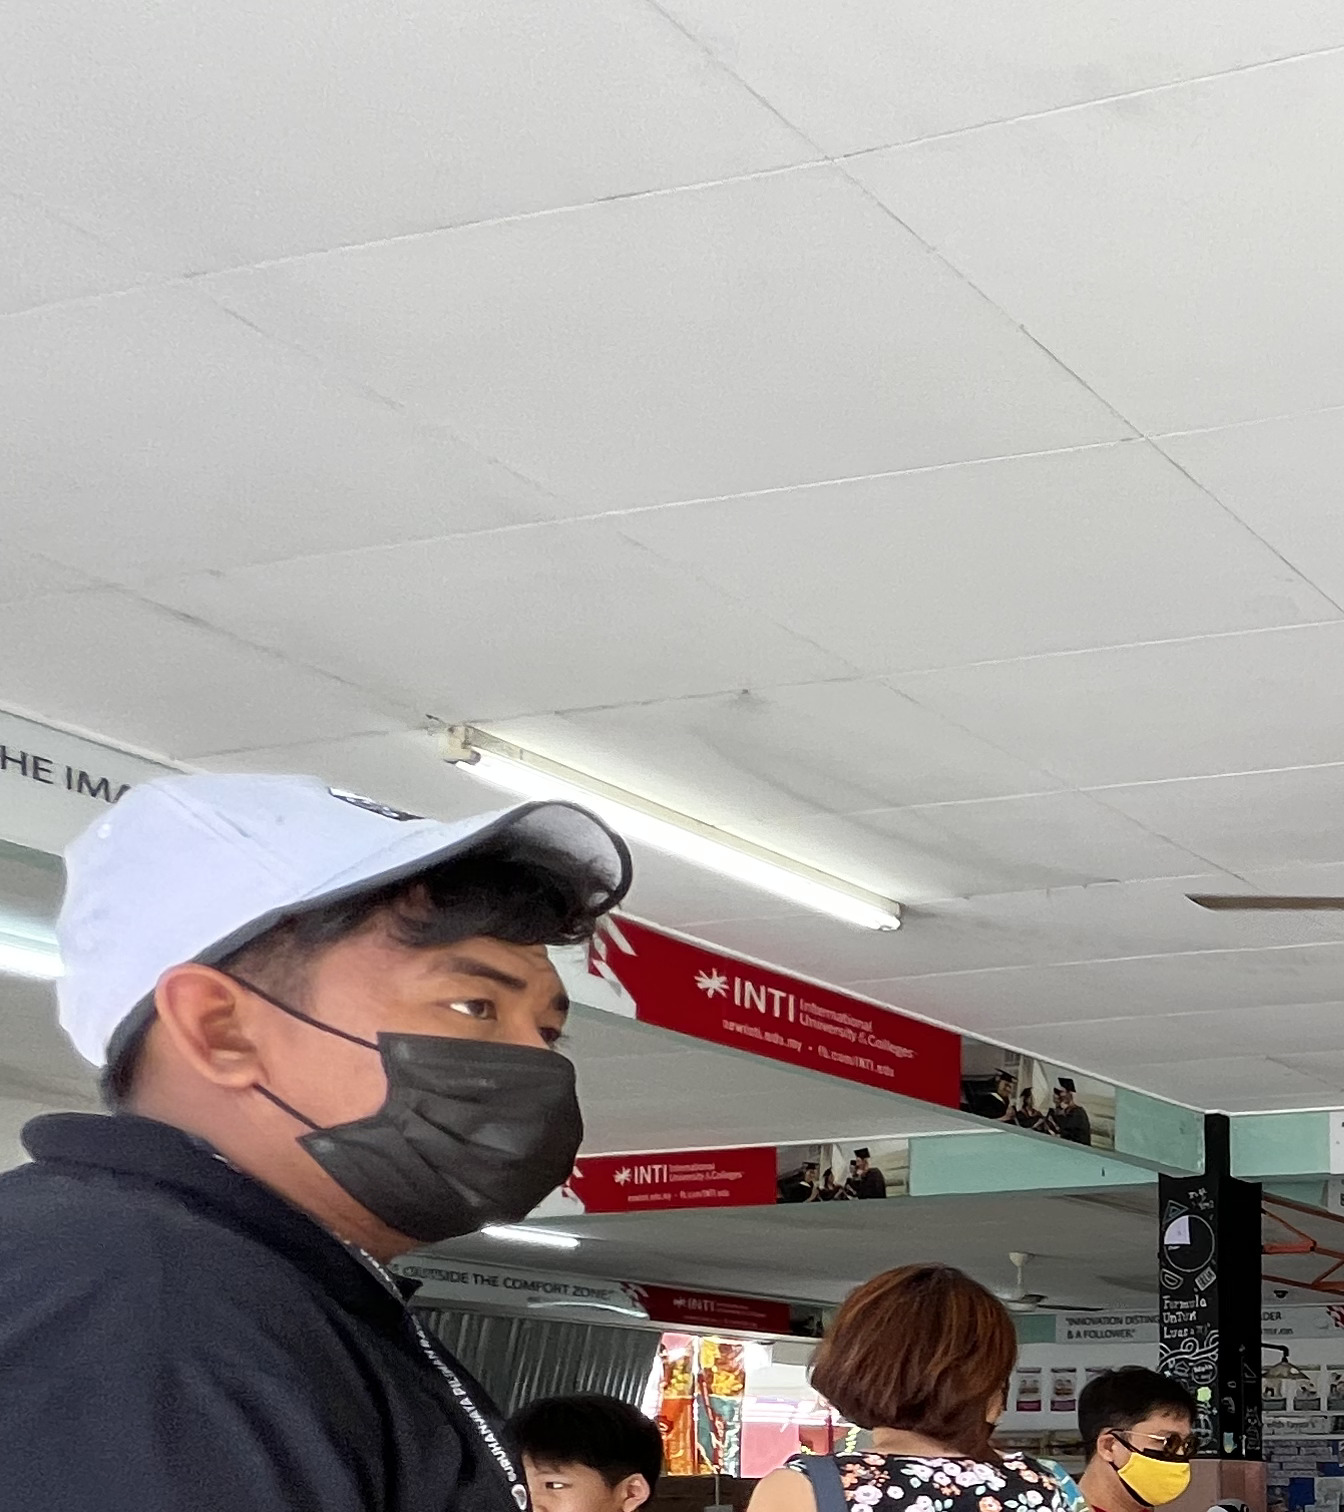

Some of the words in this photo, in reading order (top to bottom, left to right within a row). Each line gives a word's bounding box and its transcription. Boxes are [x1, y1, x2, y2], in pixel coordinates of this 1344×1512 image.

[733, 976, 795, 1023] INTI
[634, 1164, 668, 1185] INTI
[472, 1273, 499, 1288] THE
[502, 1275, 569, 1297] COMFORT
[1163, 1294, 1207, 1309] Formula
